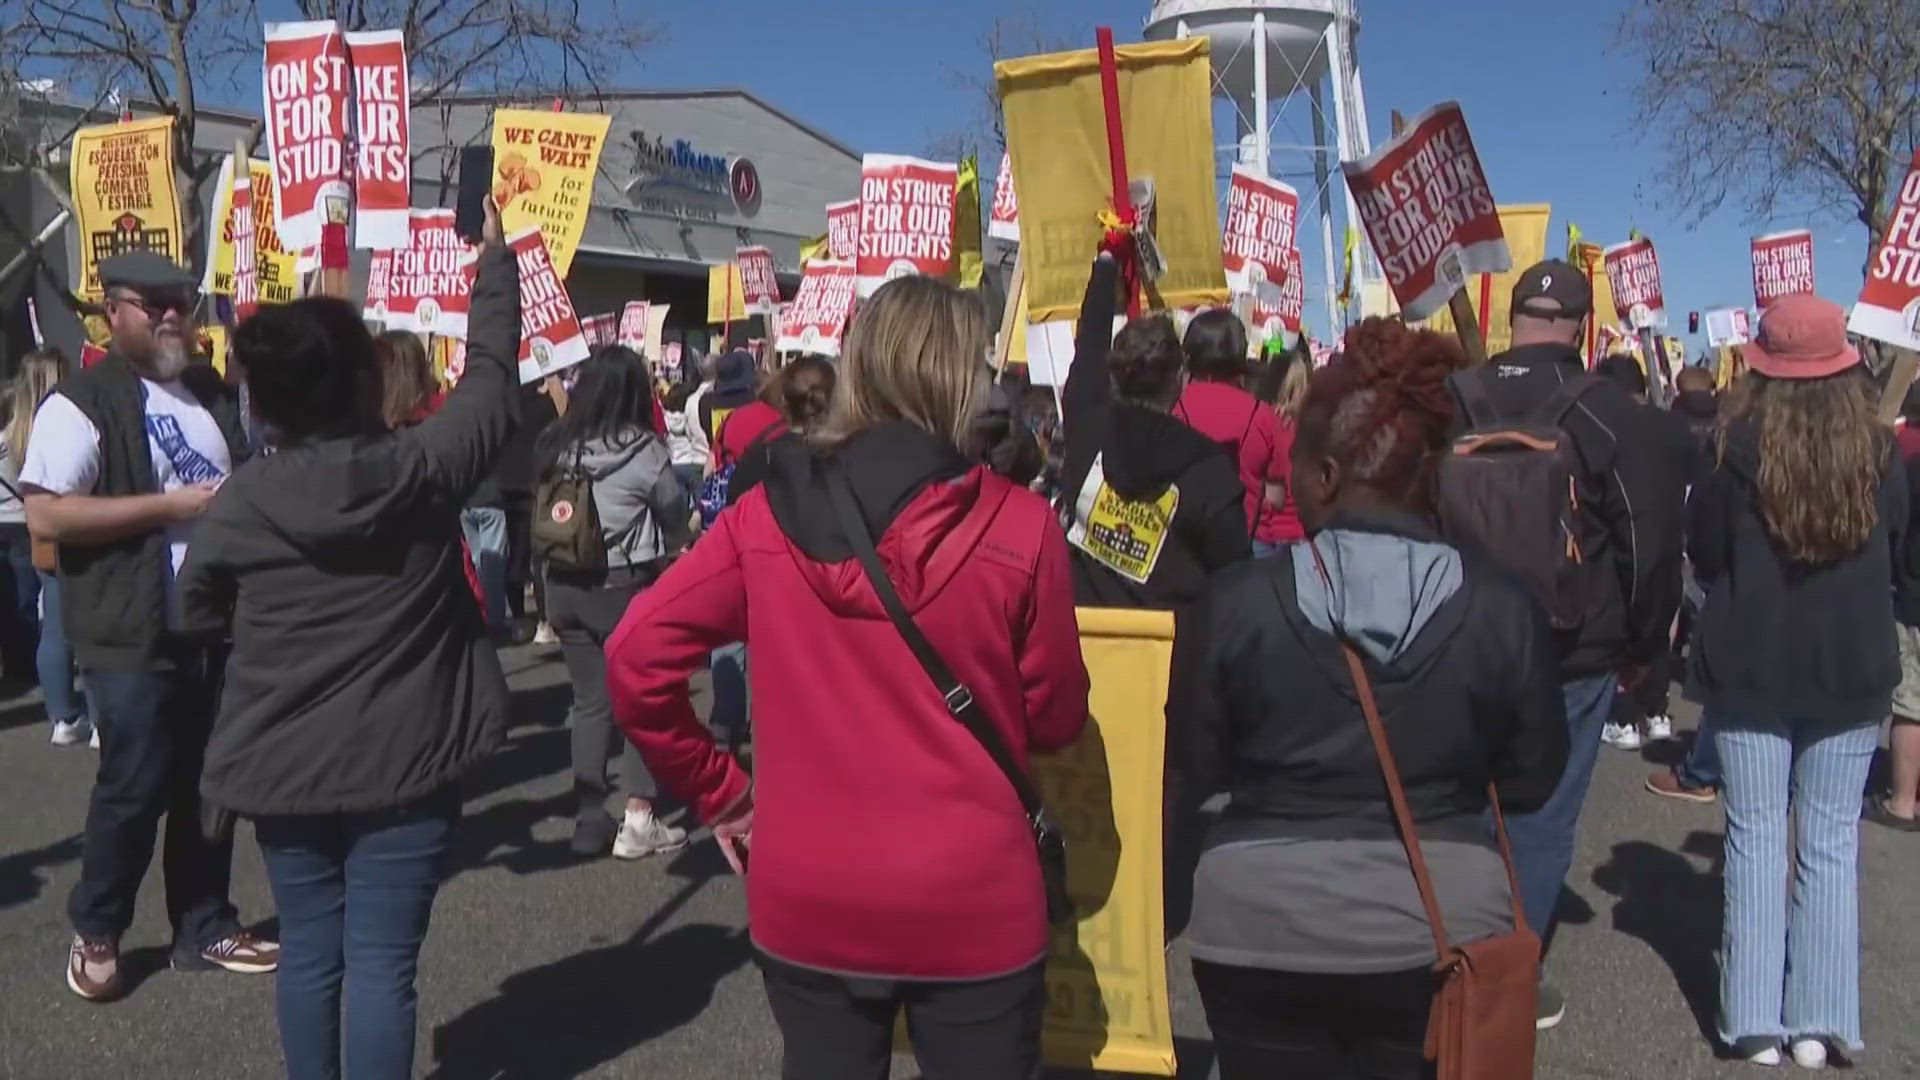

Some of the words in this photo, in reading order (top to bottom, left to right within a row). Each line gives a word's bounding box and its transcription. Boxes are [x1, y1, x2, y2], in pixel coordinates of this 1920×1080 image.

[271, 58, 308, 101] ON
[313, 54, 399, 101] STIKE
[275, 92, 333, 147] FOR
[504, 127, 534, 144] WE
[537, 128, 597, 150] CAN'T
[89, 145, 137, 166] ESCUELAS
[139, 143, 160, 160] CON
[540, 146, 591, 170] WAIT
[98, 160, 149, 178] PERSONAL
[1358, 181, 1396, 222] ON
[1391, 124, 1470, 200] STRIKE
[94, 177, 150, 196] COMPLETO
[561, 175, 586, 192] for
[862, 176, 889, 203] ON
[891, 178, 953, 208] STRIKE
[98, 196, 105, 212] Y
[108, 194, 154, 211] ESTABLE
[521, 198, 575, 222] future
[554, 190, 579, 207] the
[1230, 184, 1248, 210] ON
[1250, 191, 1295, 225] STRIKE
[1373, 197, 1428, 256] FOR
[1425, 153, 1477, 214] OUR
[862, 201, 904, 235] FOR
[908, 203, 952, 238] OUR
[1227, 205, 1259, 236] FOR
[1261, 216, 1293, 249] OUR
[859, 232, 952, 261] STUDENTS
[1383, 186, 1494, 286] STUDENTS
[392, 249, 426, 275] FOR
[1223, 231, 1291, 271] STUDENTS
[1620, 246, 1655, 271] STRIKE
[1752, 248, 1769, 265] ON
[1770, 241, 1810, 263] STRIKE
[800, 273, 820, 292] ON
[1541, 275, 1552, 292] 9
[1634, 262, 1660, 289] OUR
[1755, 262, 1781, 285] FOR
[1783, 257, 1811, 279] OUR
[214, 272, 231, 290] WE
[266, 282, 293, 301] WAIT
[390, 272, 469, 298] STUDENTS
[1755, 274, 1813, 299] STUDENTS
[794, 290, 821, 312] FOR
[820, 288, 853, 311] OUR
[790, 307, 847, 328] STUDENTS
